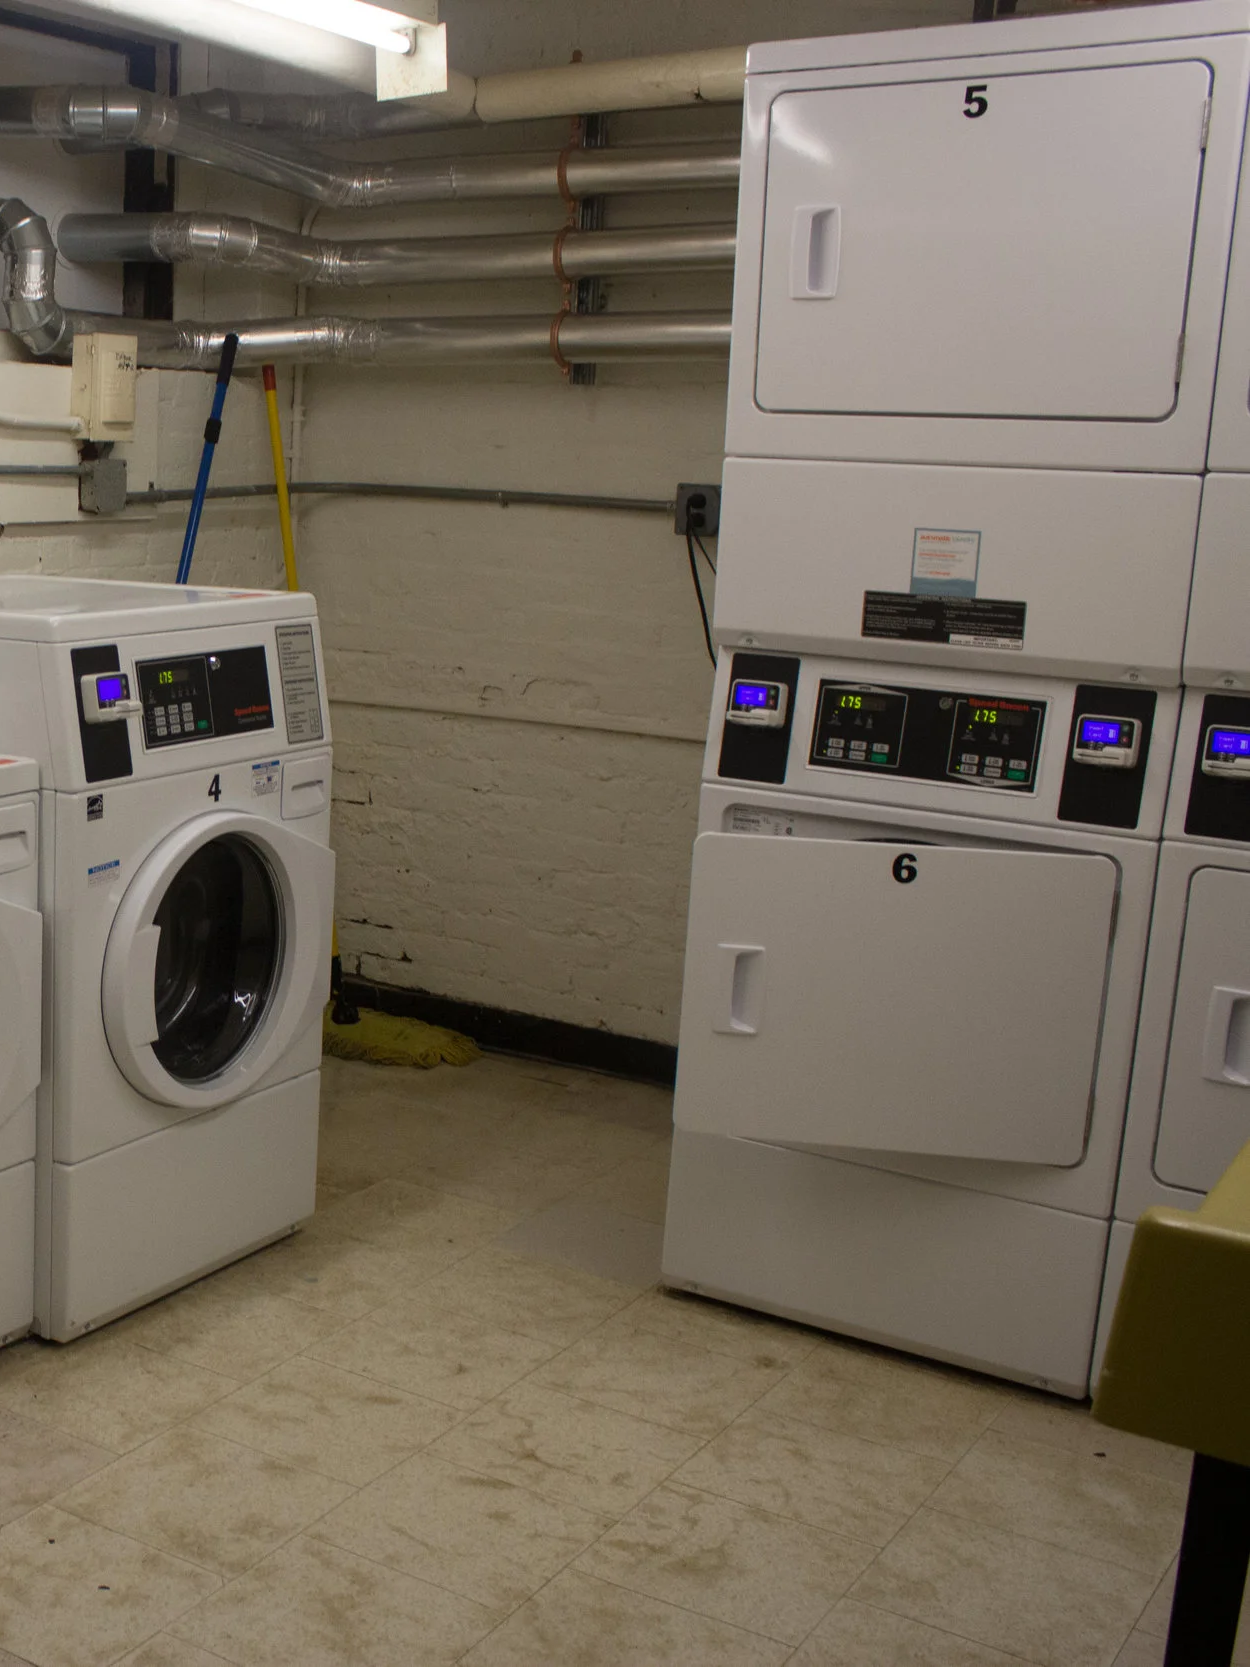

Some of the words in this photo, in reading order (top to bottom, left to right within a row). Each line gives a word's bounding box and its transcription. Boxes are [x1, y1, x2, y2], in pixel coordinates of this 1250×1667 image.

[963, 84, 988, 119] 5
[208, 773, 221, 802] 4
[892, 853, 918, 884] 6
